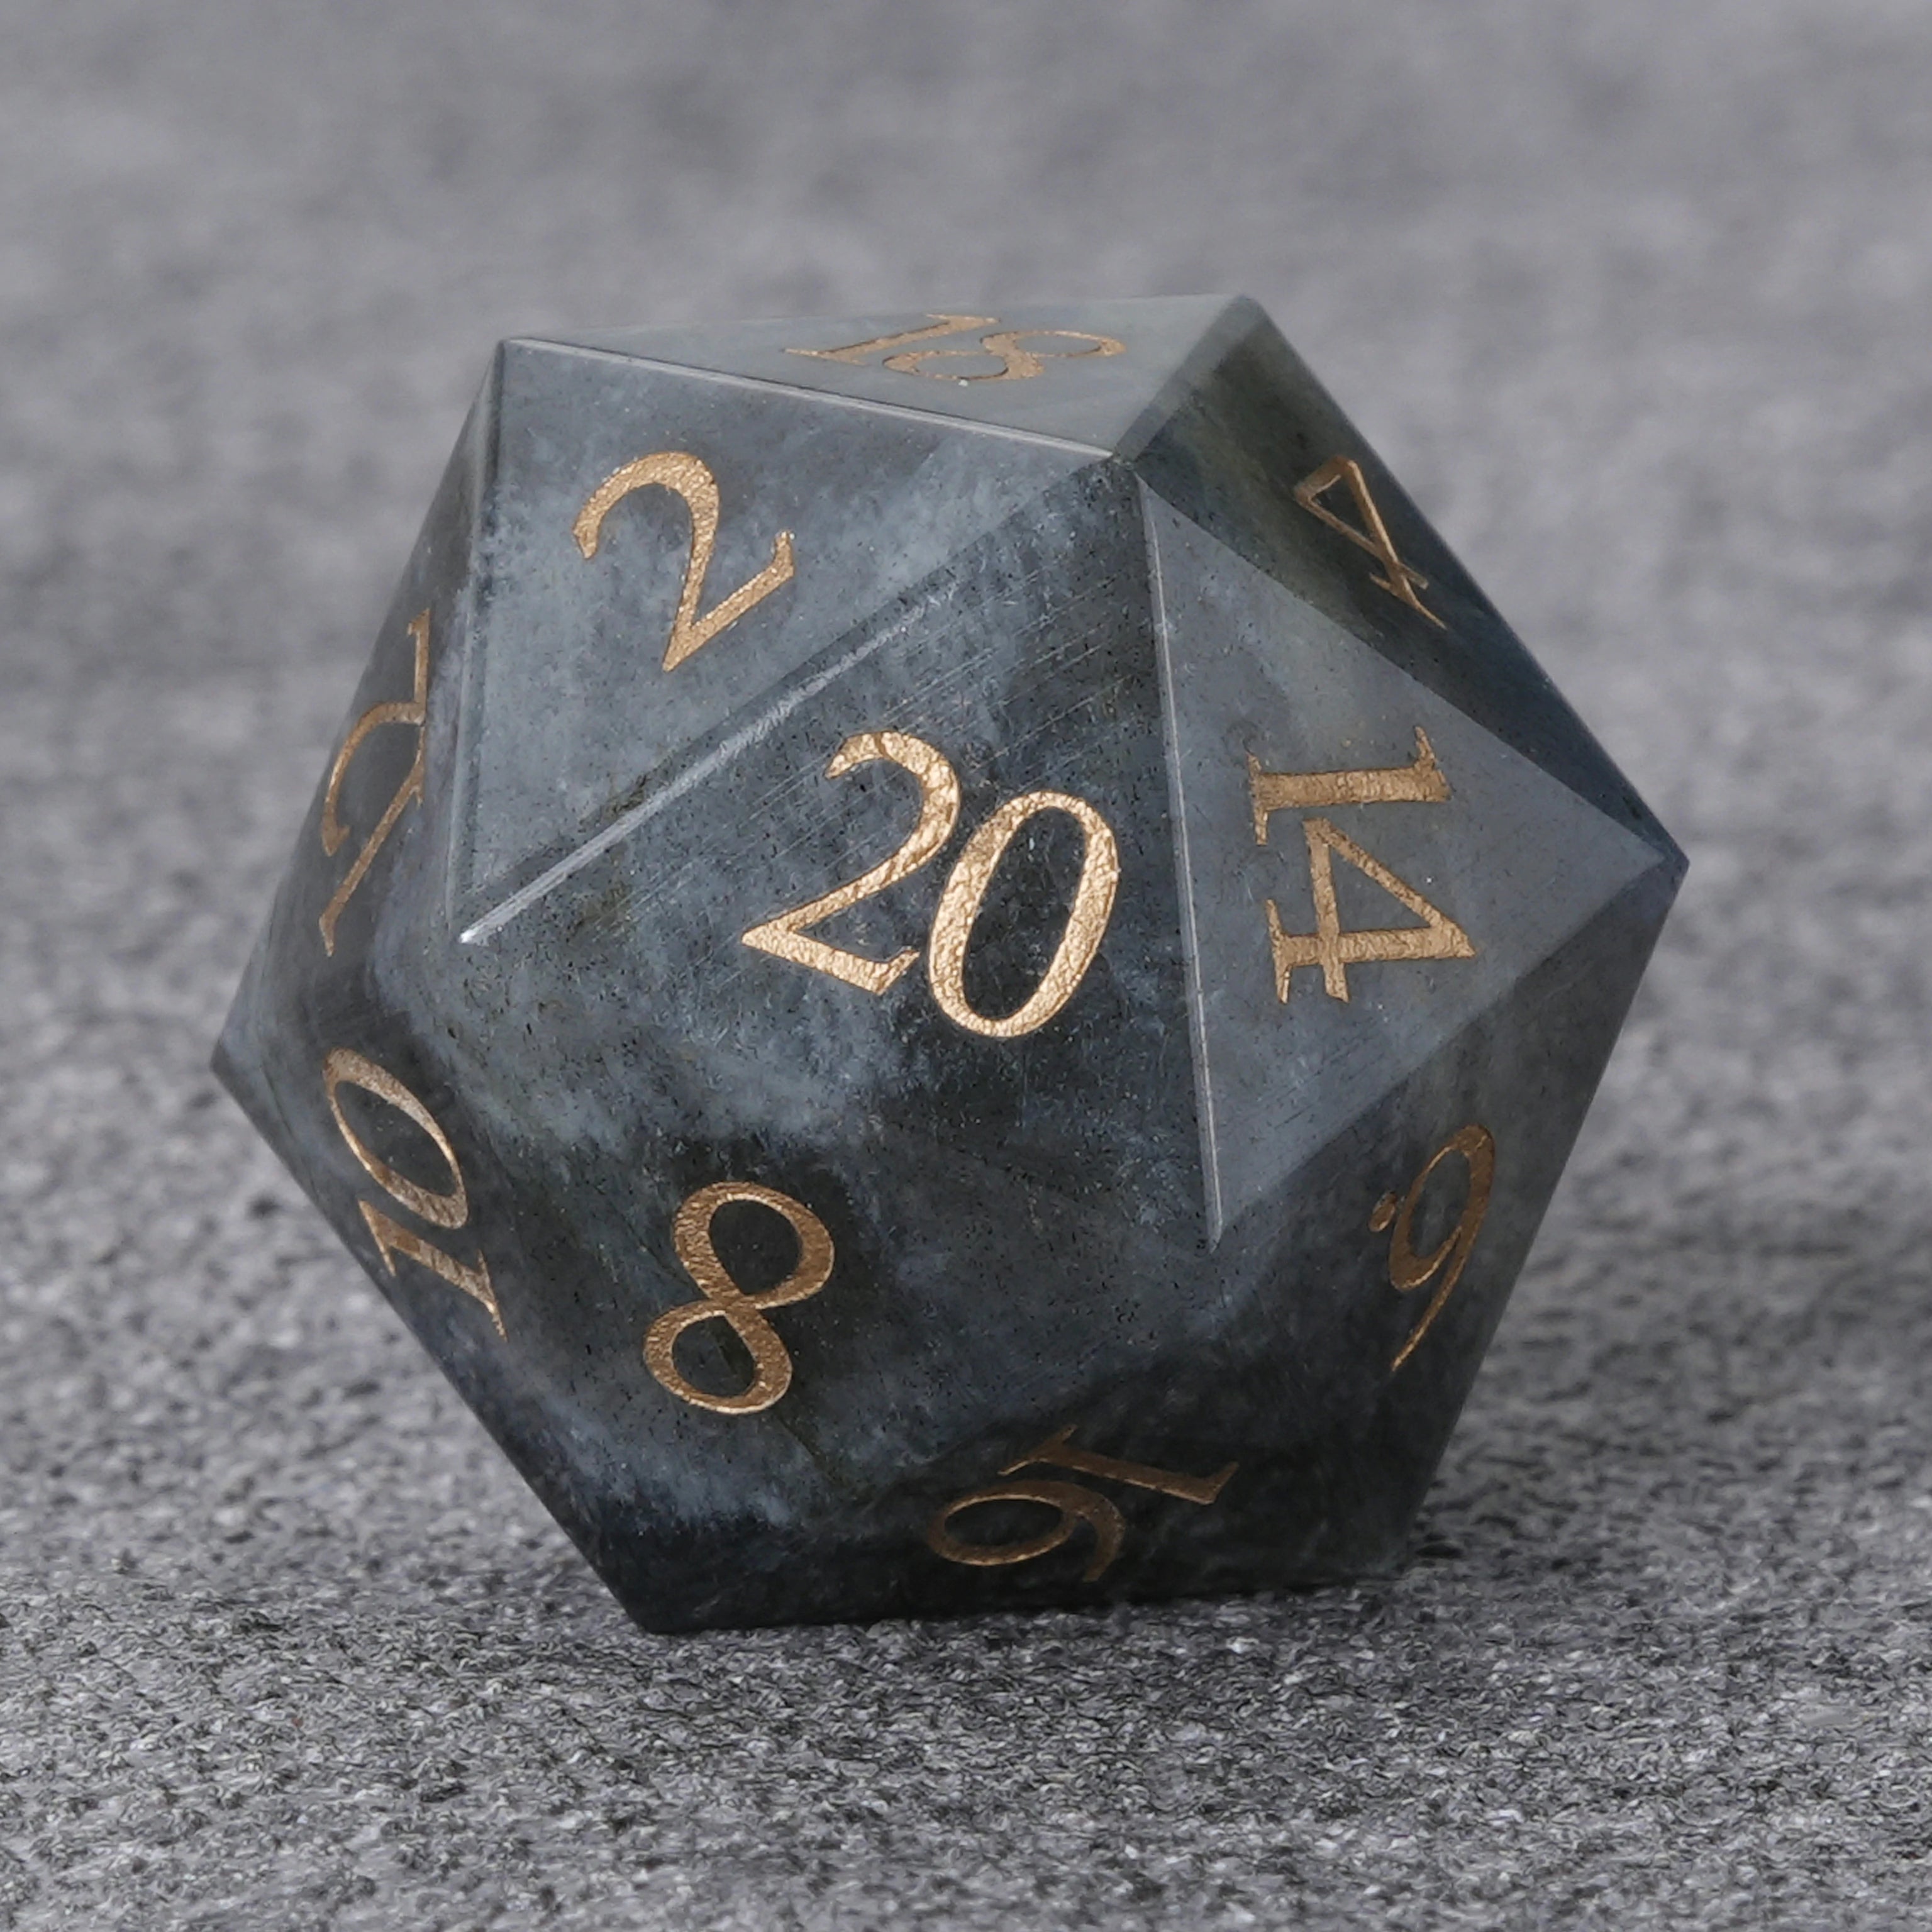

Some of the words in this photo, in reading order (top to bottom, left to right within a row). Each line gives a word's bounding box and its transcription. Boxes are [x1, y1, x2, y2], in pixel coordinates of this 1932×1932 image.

[780, 314, 1126, 380] 18
[573, 450, 795, 672] 2
[1294, 455, 1447, 629] 4
[742, 730, 1120, 1038] 20
[1248, 728, 1477, 1004] 14
[323, 1048, 508, 1341] 10
[643, 1180, 836, 1415] 8
